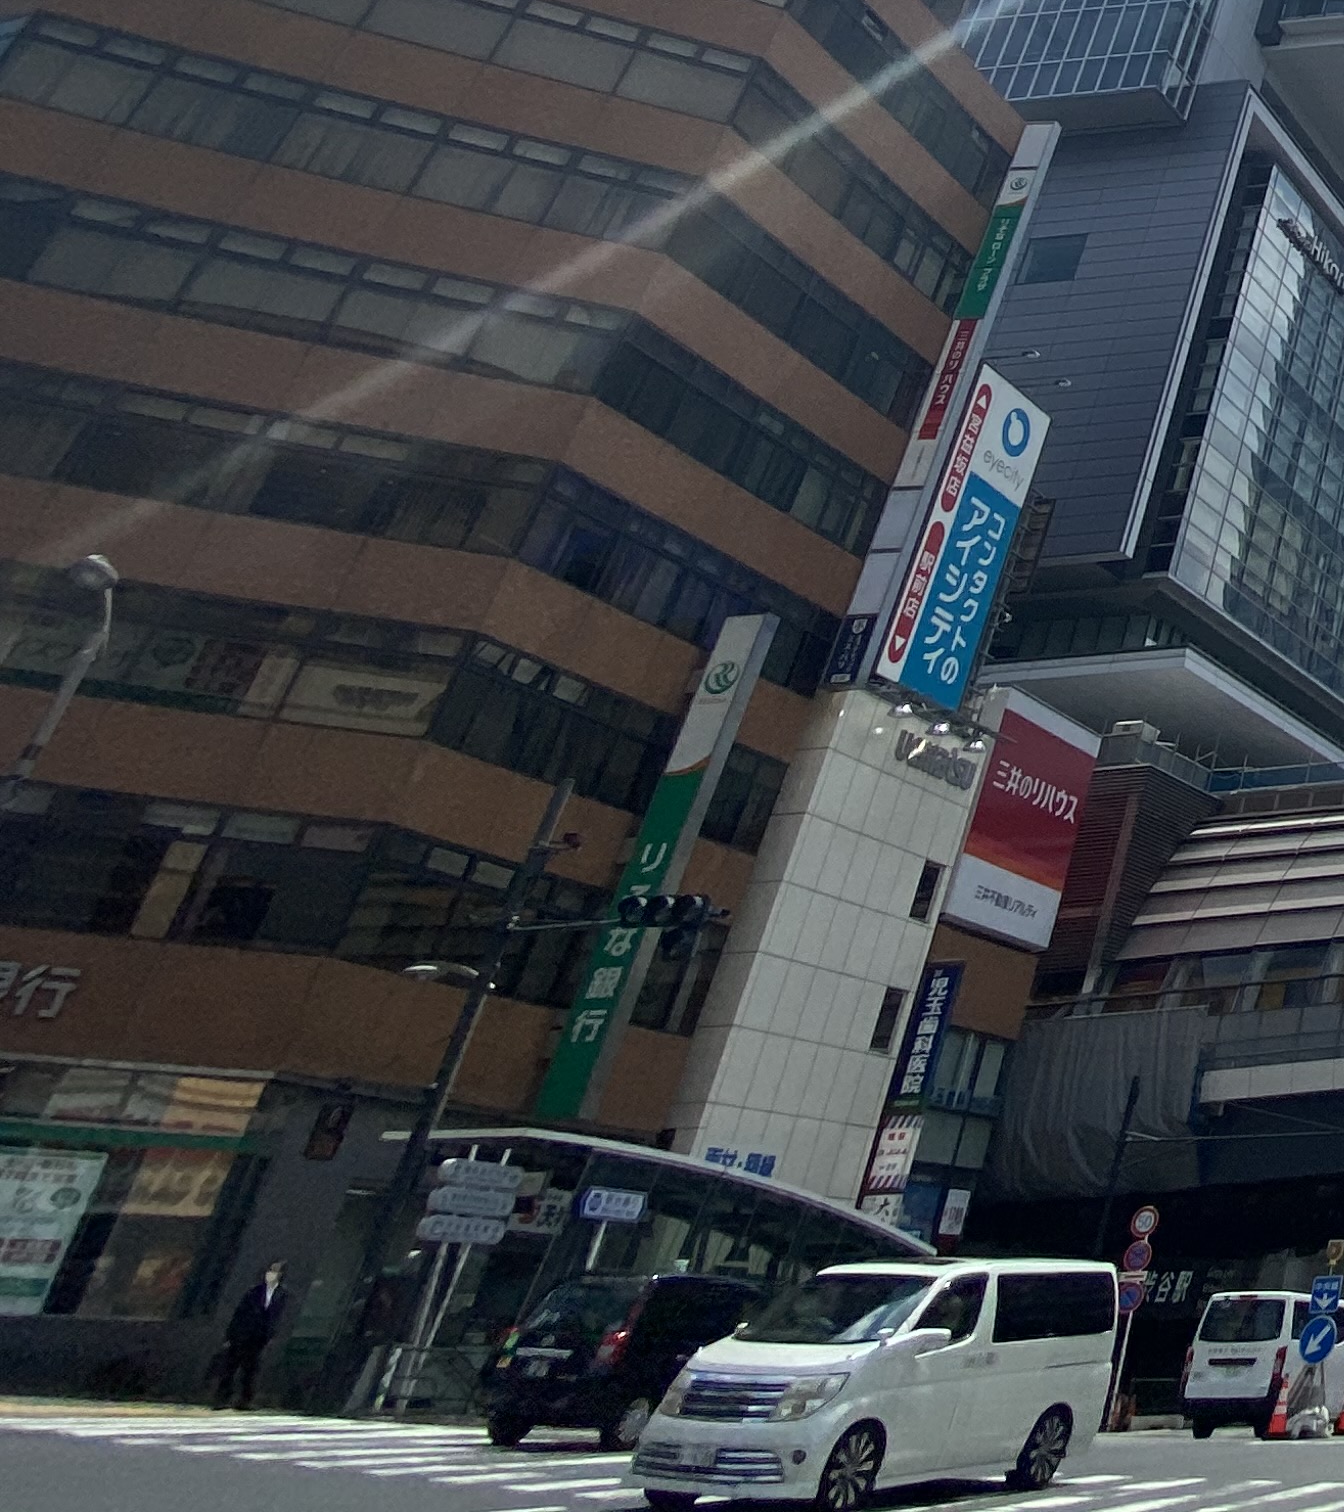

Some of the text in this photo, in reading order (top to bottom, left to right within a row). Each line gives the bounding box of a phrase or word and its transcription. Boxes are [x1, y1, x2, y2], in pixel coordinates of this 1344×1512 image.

[982, 448, 1026, 491] eyecity
[921, 495, 991, 675] アイシティ
[939, 512, 1007, 685] コンタクトの
[992, 759, 1079, 824] 三井のリハウス
